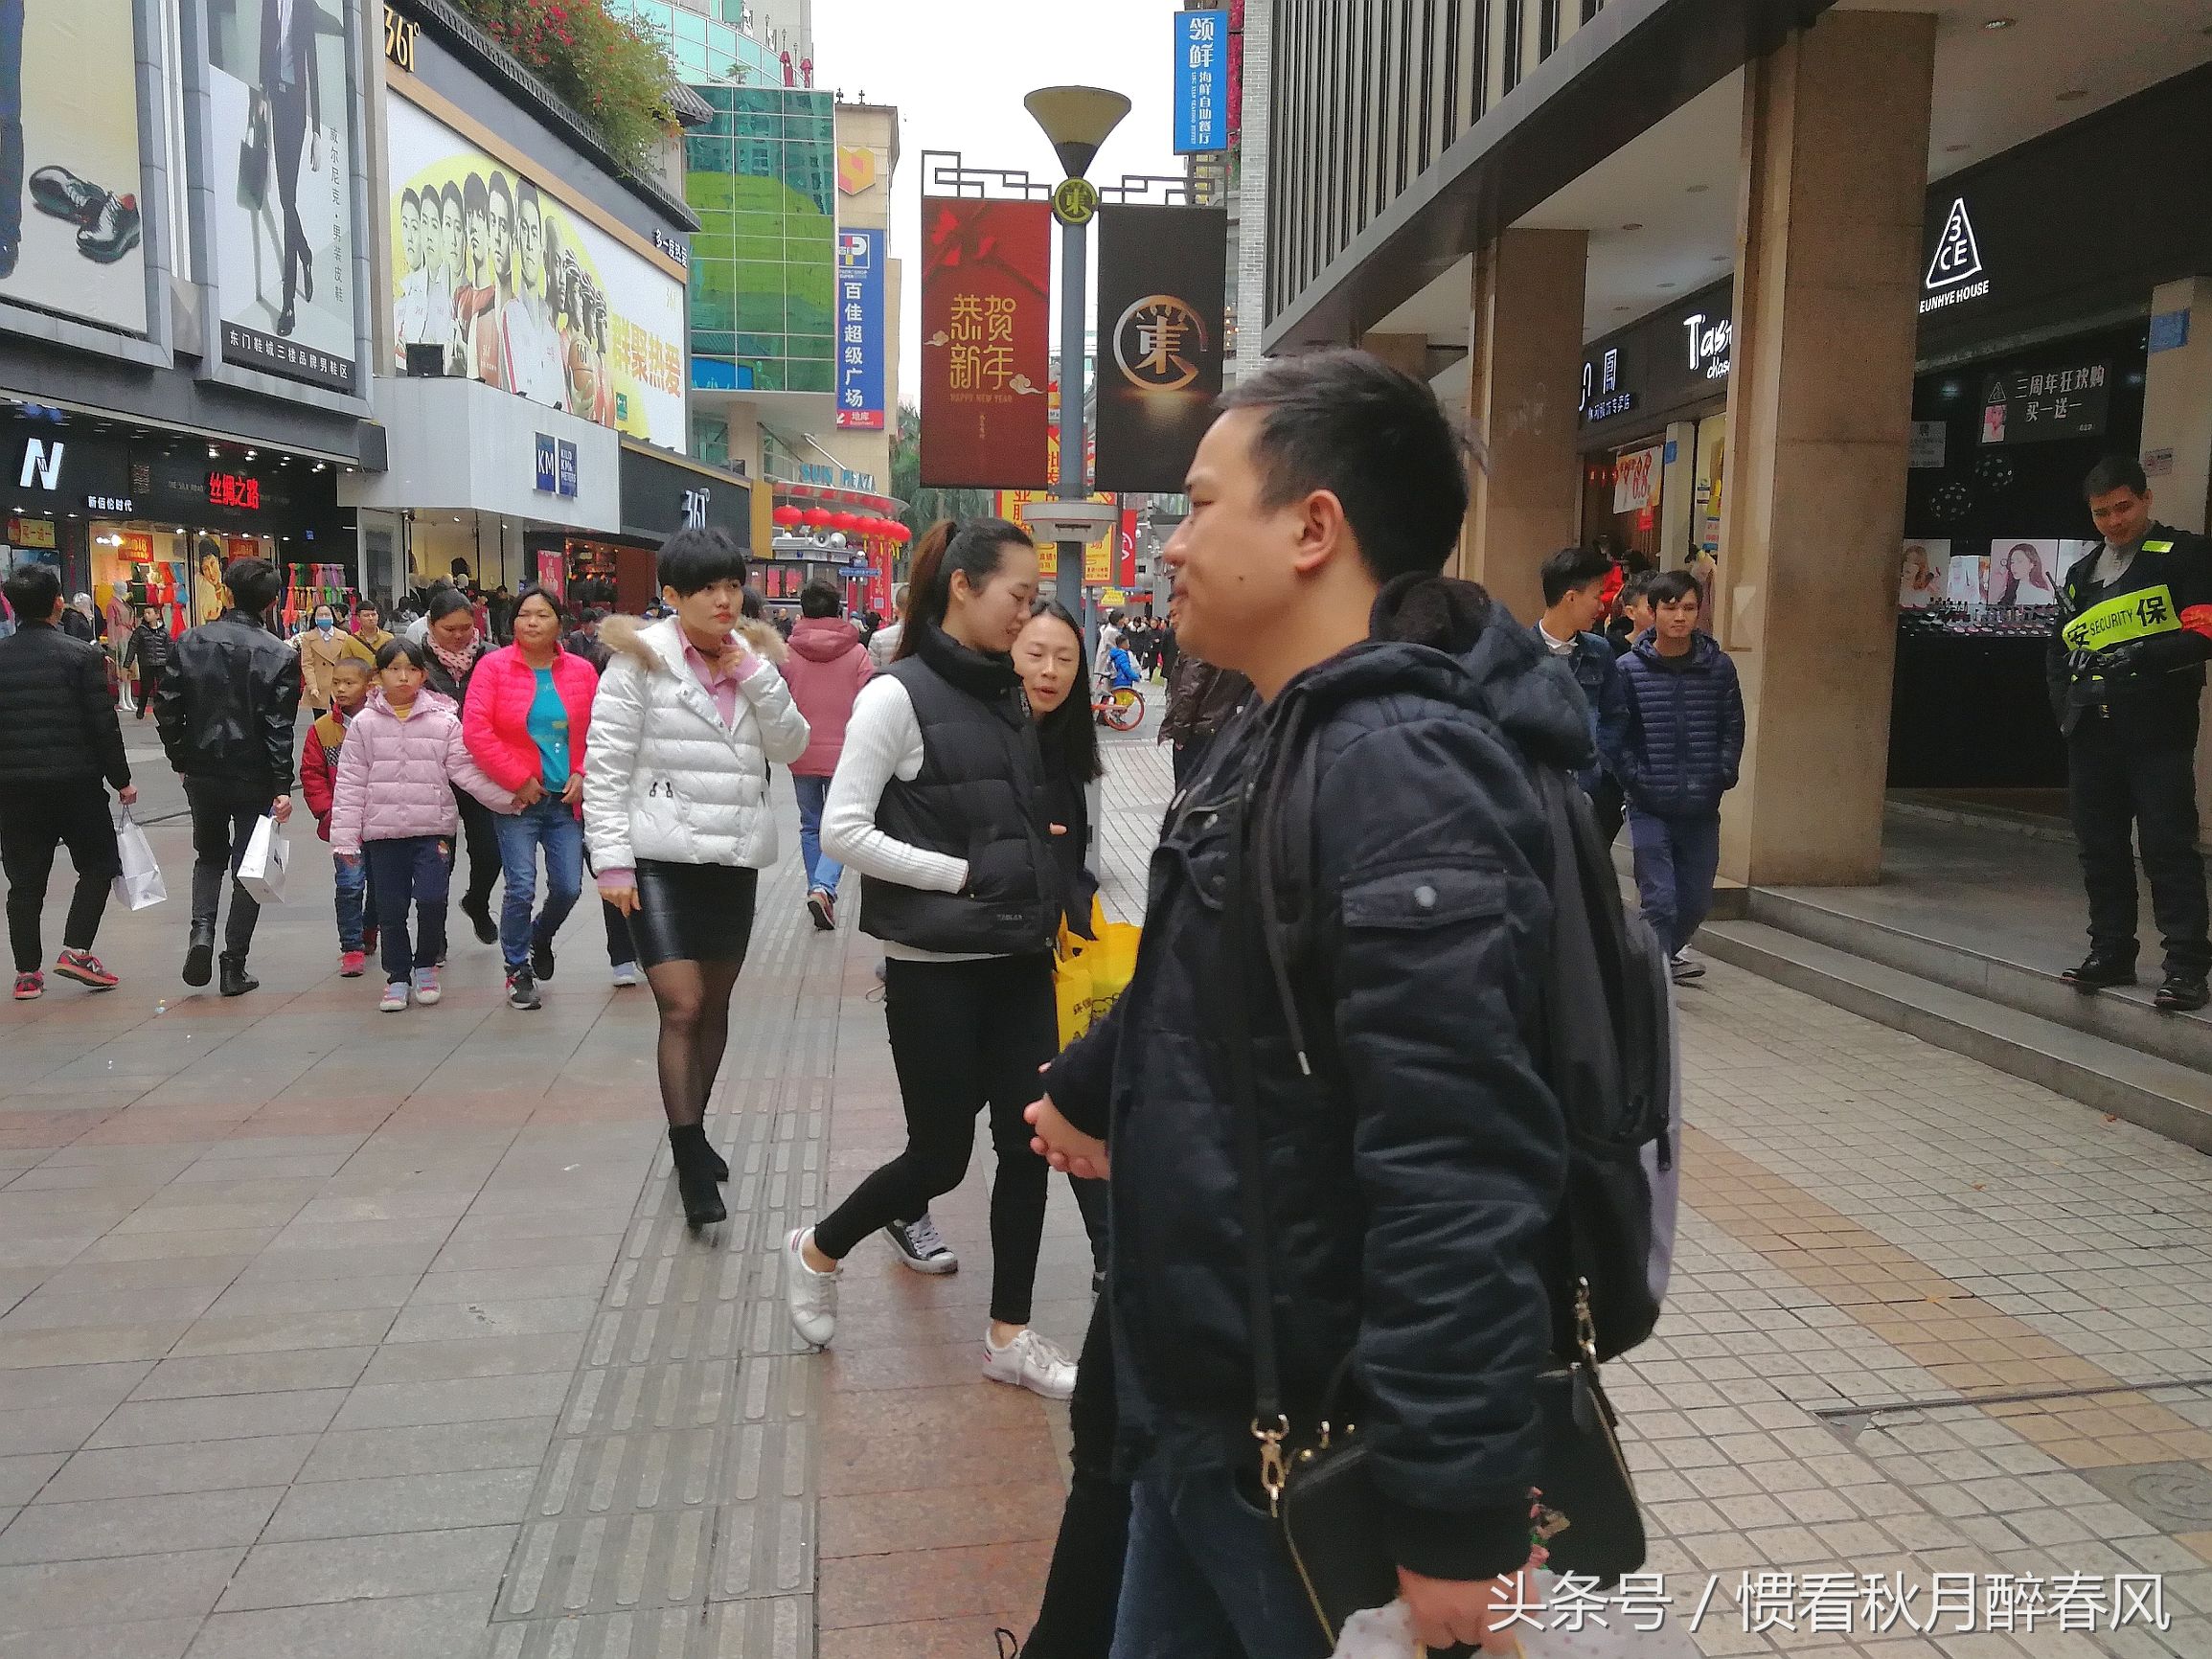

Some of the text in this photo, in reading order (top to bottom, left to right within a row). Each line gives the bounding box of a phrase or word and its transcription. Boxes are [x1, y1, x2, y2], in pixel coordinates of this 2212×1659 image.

[1189, 17, 1215, 68] 领鲜
[1198, 71, 1212, 145] 海鲜自助餐厅
[950, 293, 1016, 342] 恭贺
[1919, 280, 1990, 314] EUNHYE HOUSE
[230, 330, 349, 379] 东门鞋城三楼品牌男鞋区
[844, 282, 863, 408] 百佳超级广场
[949, 344, 1014, 390] 新年
[2015, 364, 2106, 398] 三周年狂欢购
[2025, 398, 2083, 421] 买一送一
[537, 449, 555, 476] KM
[209, 470, 260, 510] 丝绸之路
[2067, 595, 2167, 648] 安 SECURITY 保
